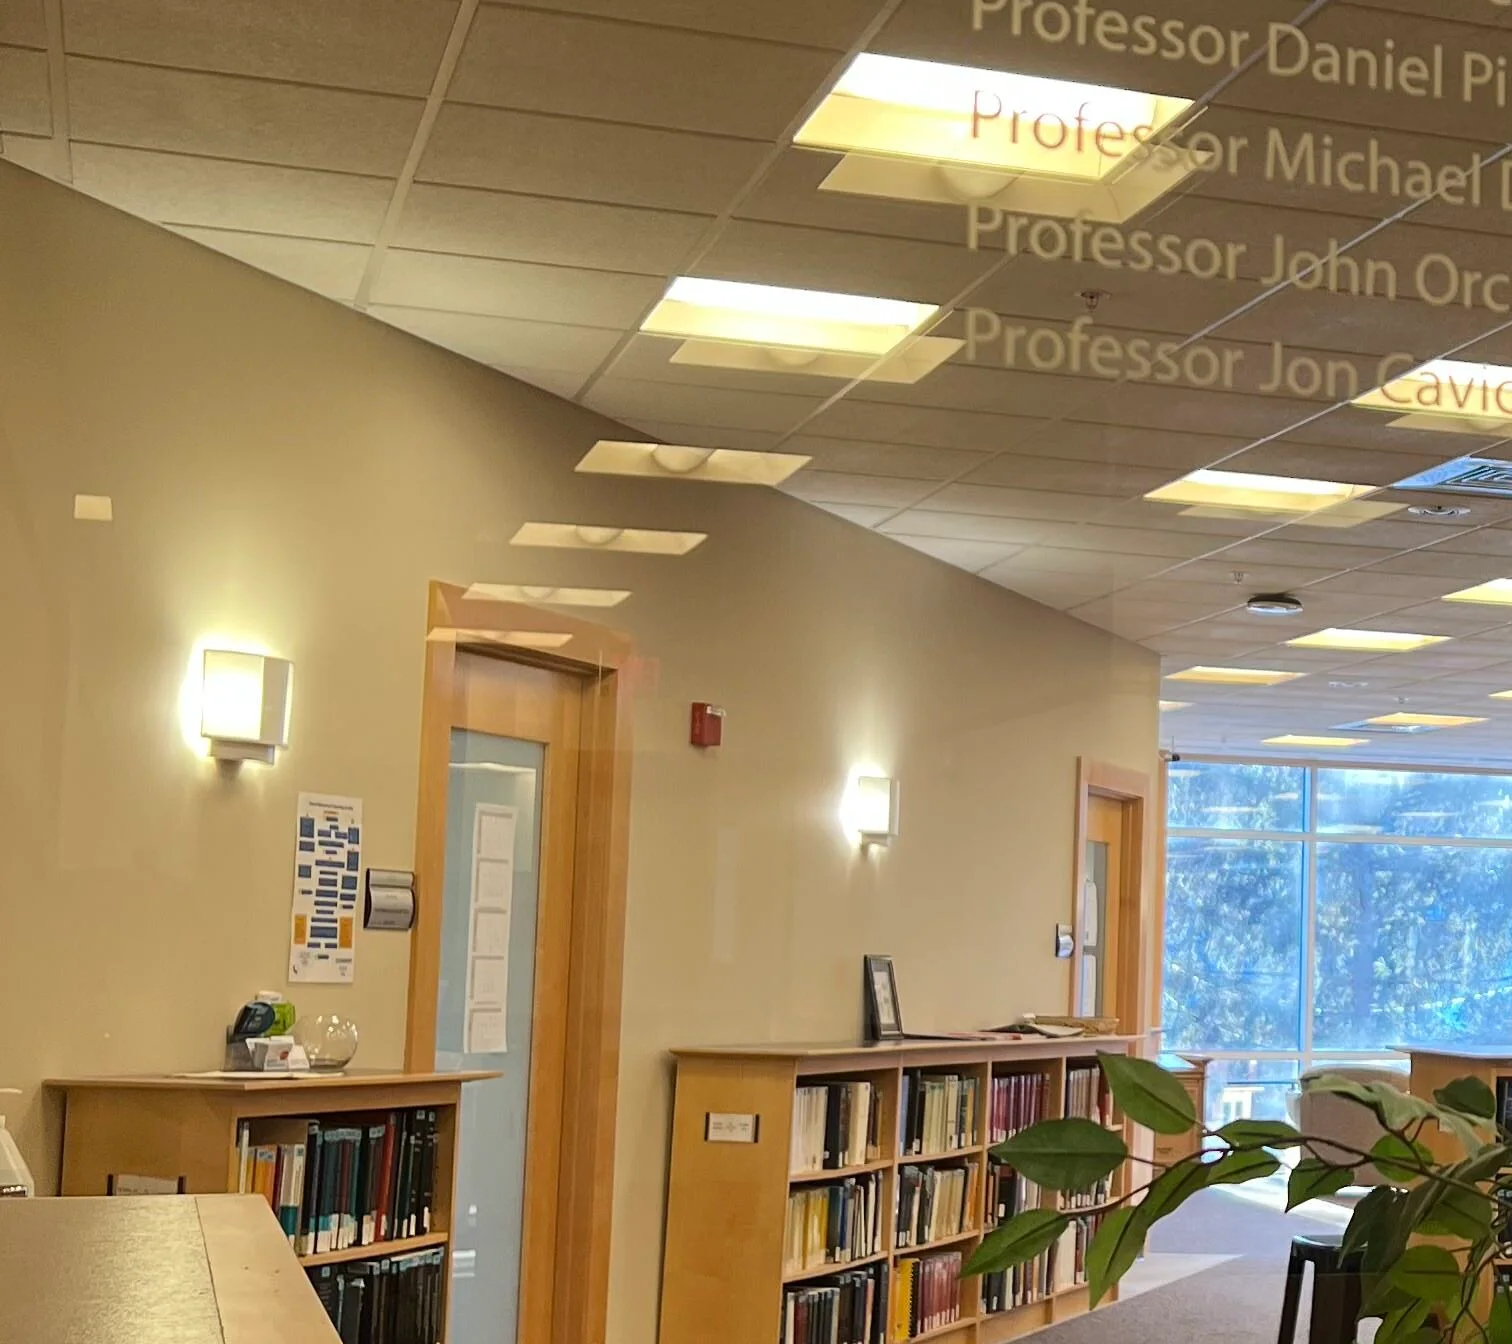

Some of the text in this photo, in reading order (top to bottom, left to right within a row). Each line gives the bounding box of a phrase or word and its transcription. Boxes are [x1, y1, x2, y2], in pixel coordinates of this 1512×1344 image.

[1268, 21, 1443, 98] Daniel
[1463, 53, 1506, 108] Pi
[971, 89, 1248, 171] Professor
[1264, 127, 1482, 207] Michael
[968, 198, 1245, 280] Professor
[1261, 235, 1396, 301] John
[965, 306, 1244, 389] Professor
[1260, 341, 1357, 401] Jon
